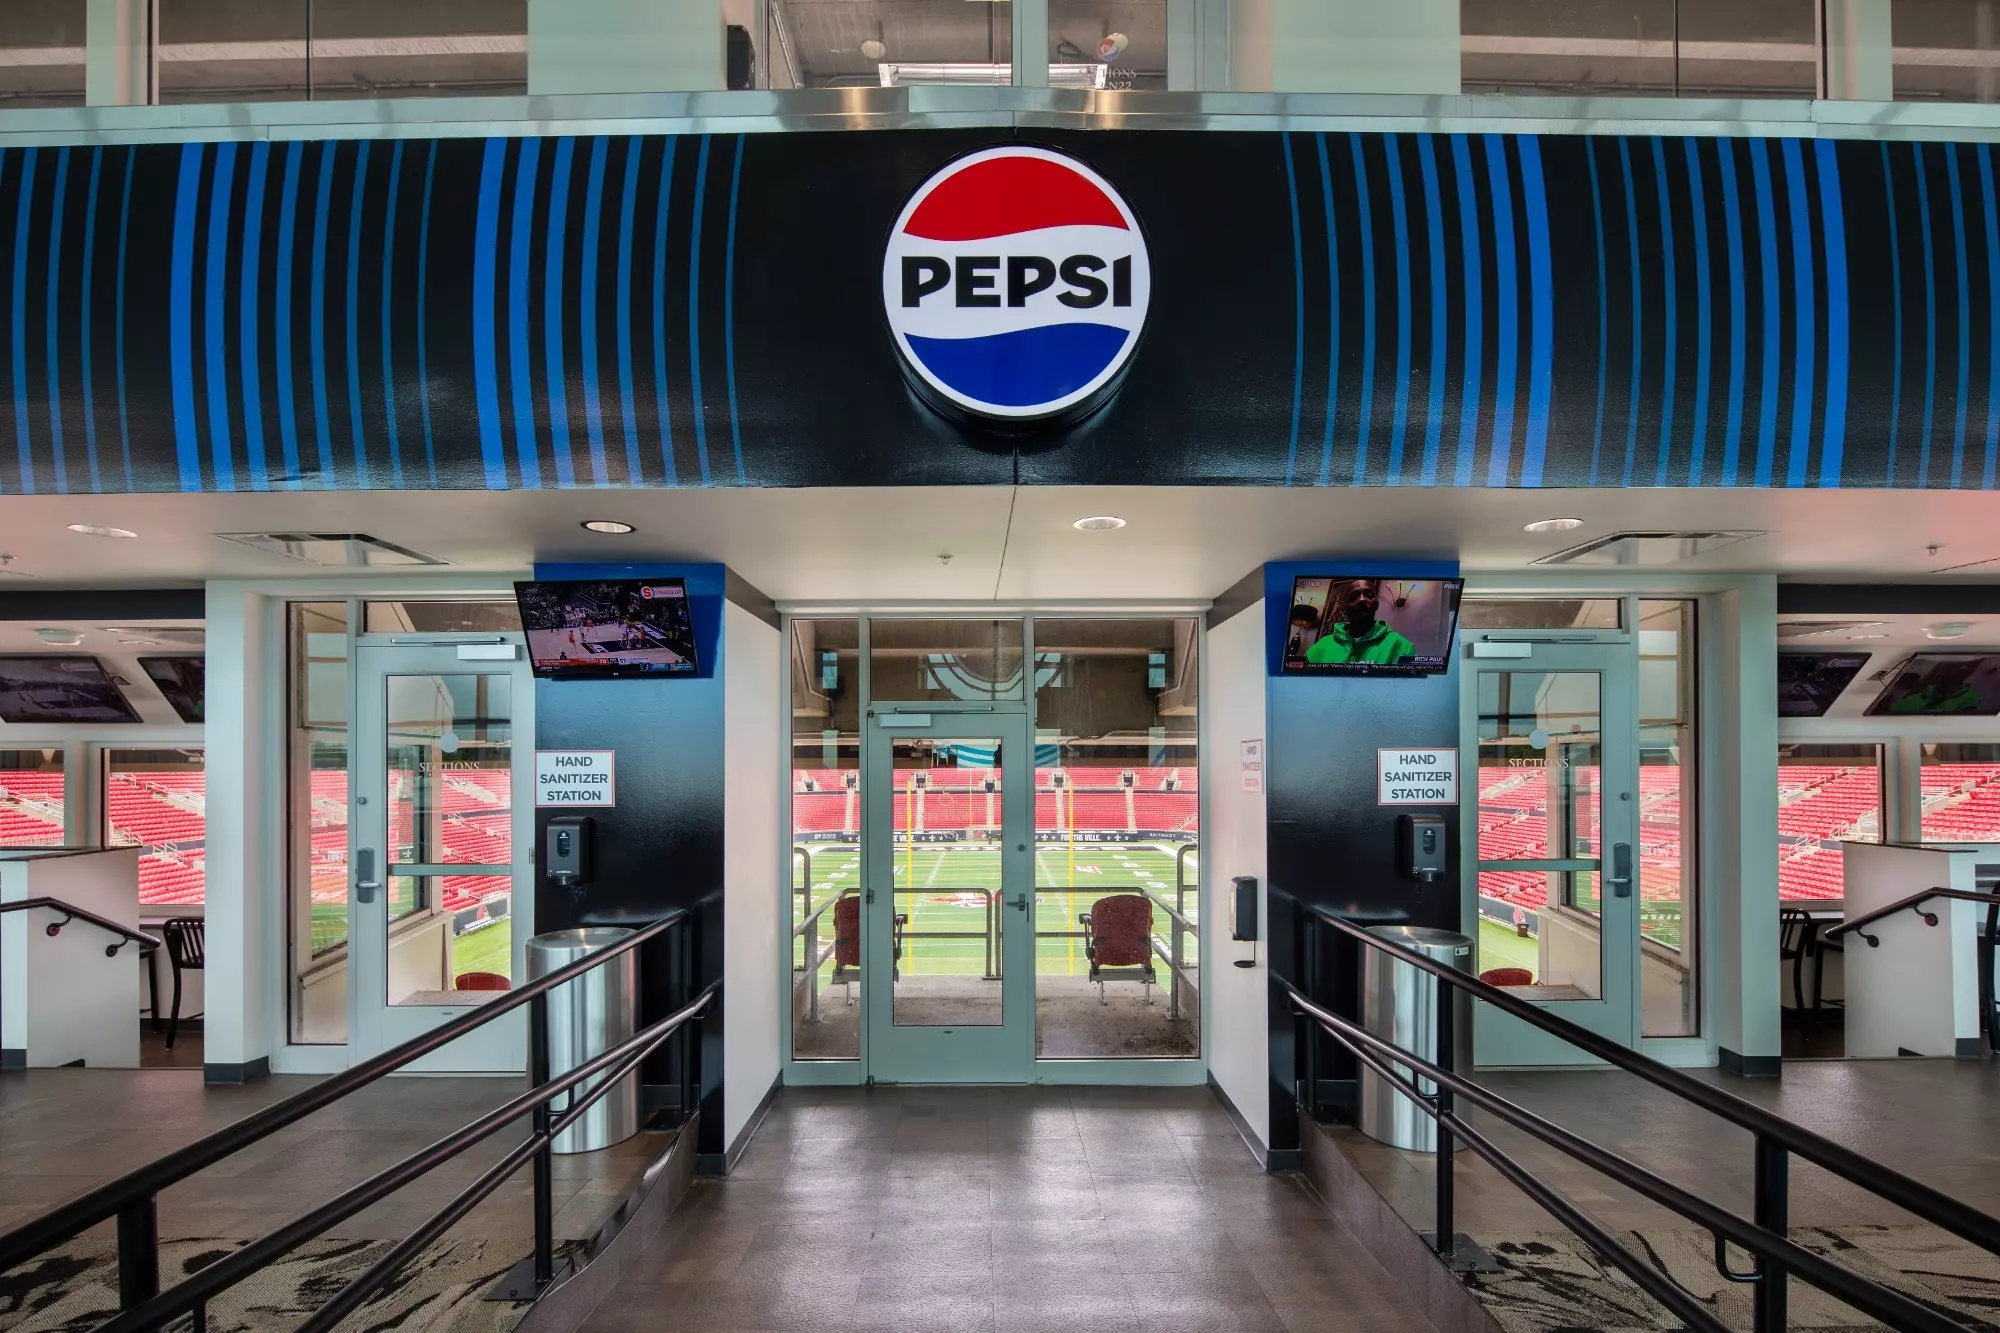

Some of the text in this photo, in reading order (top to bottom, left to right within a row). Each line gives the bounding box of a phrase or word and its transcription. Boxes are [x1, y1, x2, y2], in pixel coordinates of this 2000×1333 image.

[901, 254, 1132, 309] PEPSI
[555, 756, 593, 767] HAND
[1399, 754, 1436, 765] HAND
[1508, 758, 1569, 769] SECTIONS
[419, 762, 480, 772] SECTIONS
[540, 773, 608, 784] SANITIZER
[1384, 771, 1452, 782] SANITIZER
[547, 790, 601, 801] STATION
[1391, 788, 1445, 799] STATION
